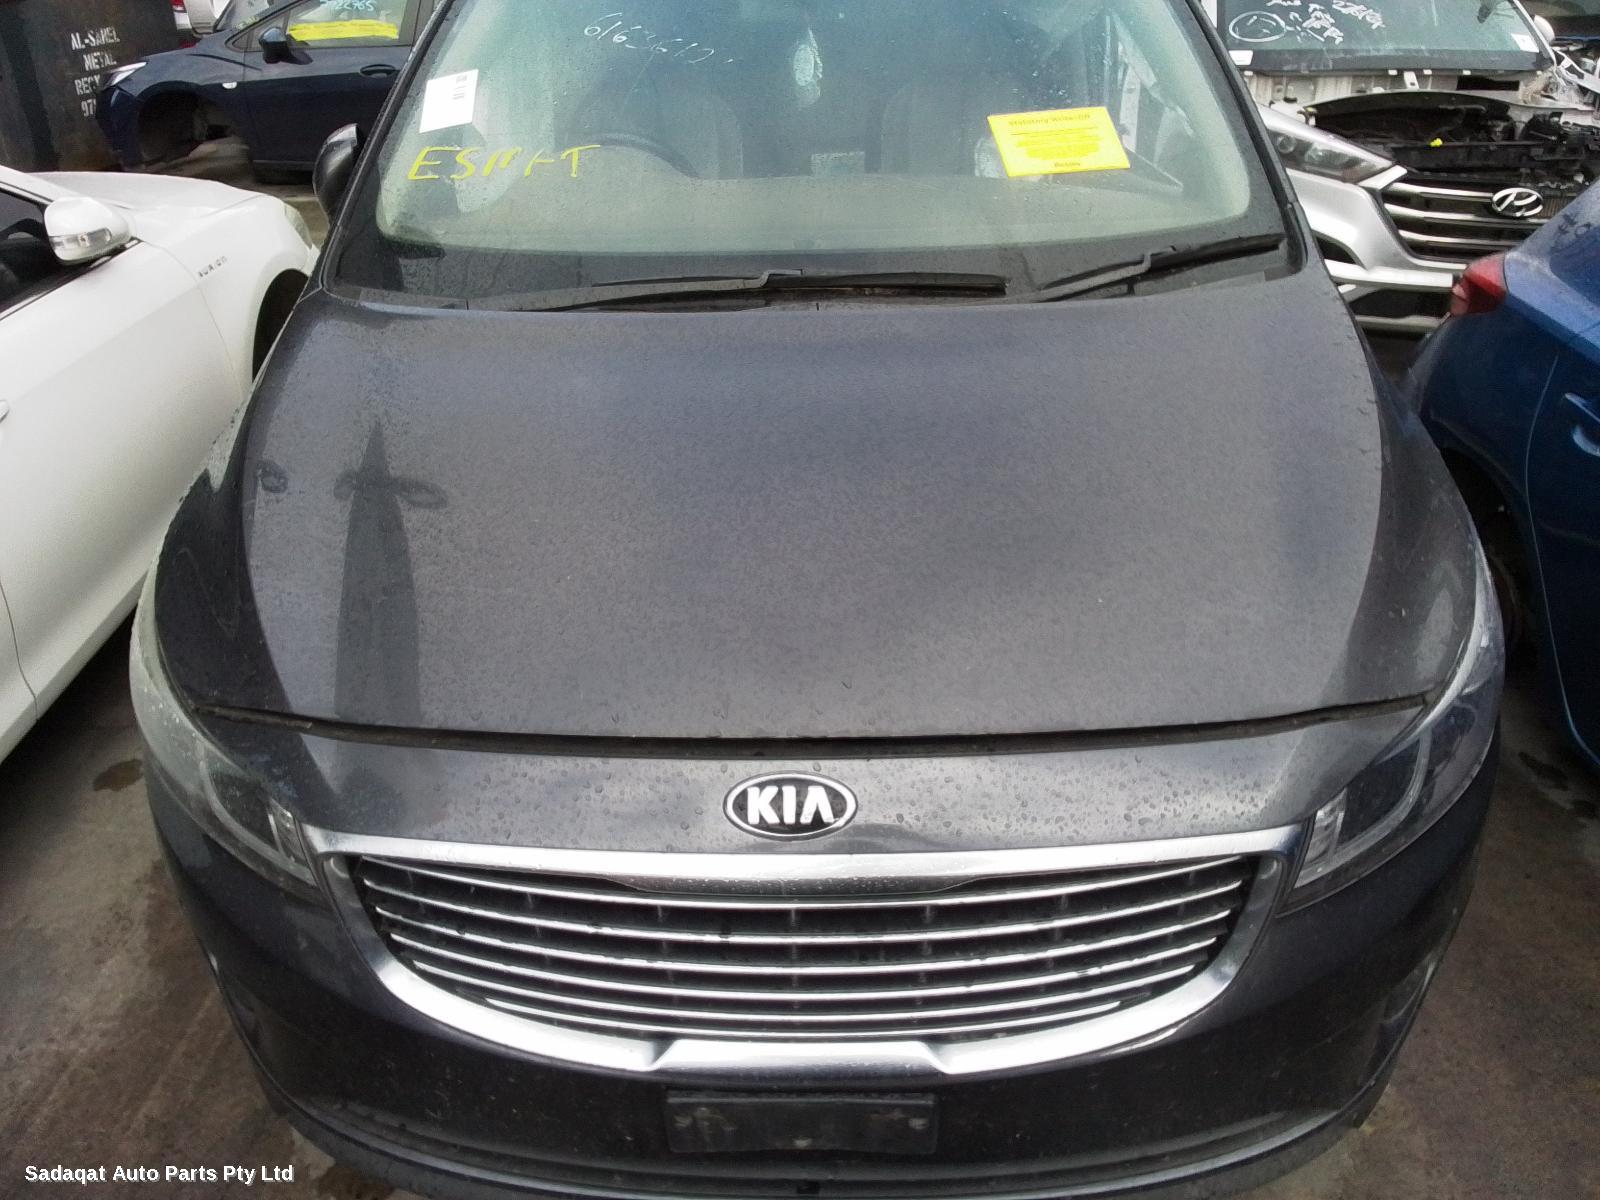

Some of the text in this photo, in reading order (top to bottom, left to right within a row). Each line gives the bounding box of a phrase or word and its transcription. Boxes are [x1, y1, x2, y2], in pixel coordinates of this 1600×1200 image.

[82, 50, 118, 72] METAL
[80, 98, 97, 118] 97
[746, 785, 836, 825] KIA
